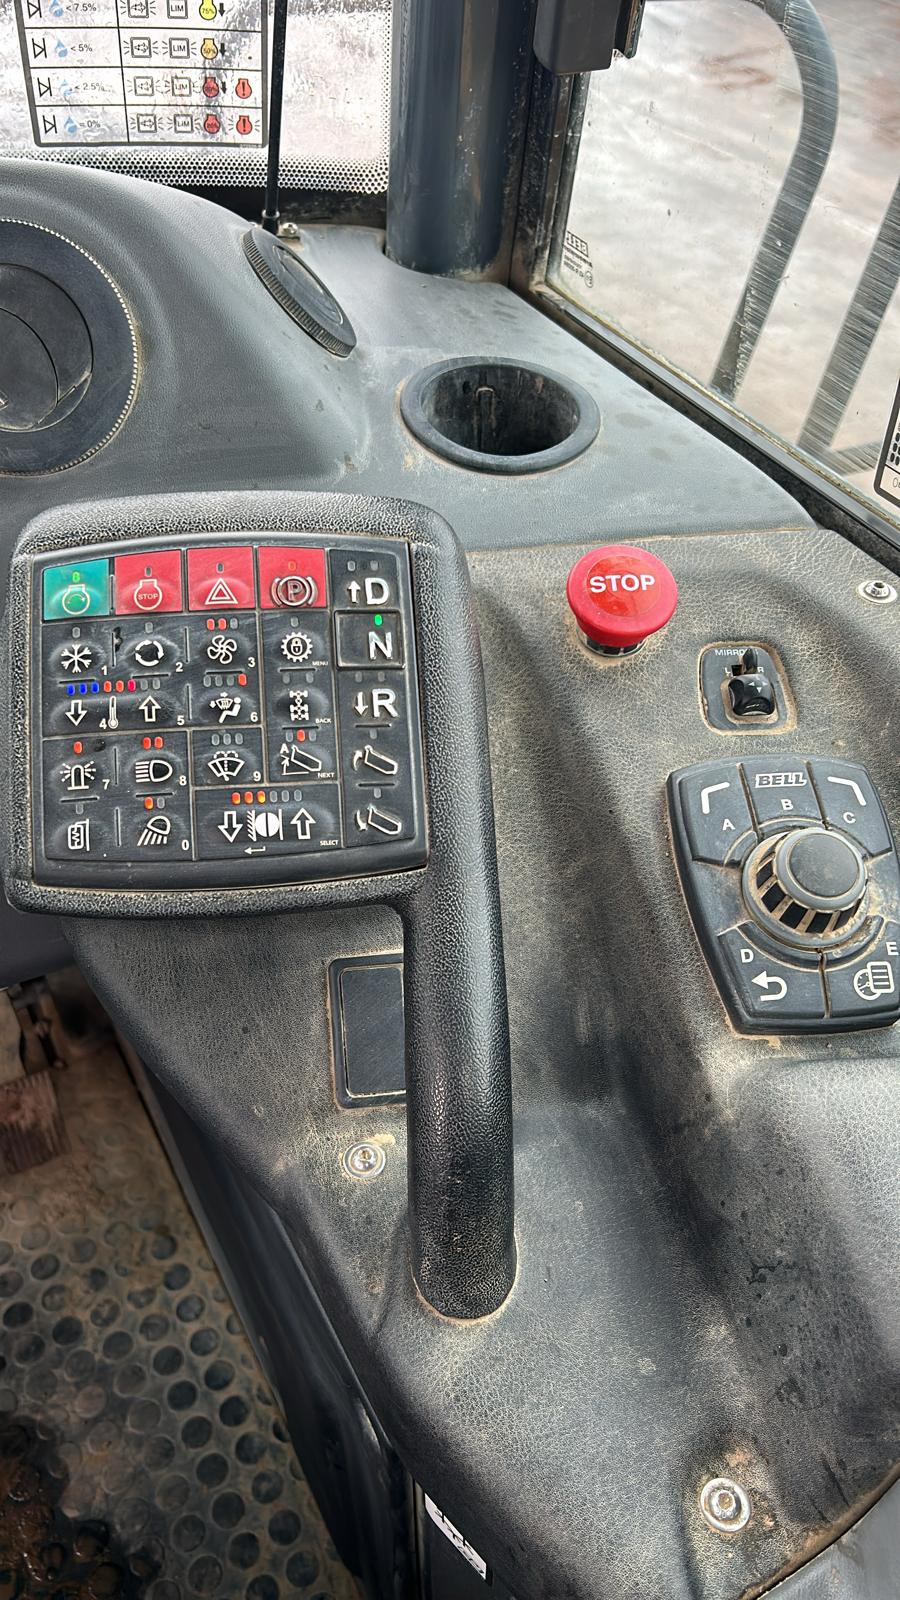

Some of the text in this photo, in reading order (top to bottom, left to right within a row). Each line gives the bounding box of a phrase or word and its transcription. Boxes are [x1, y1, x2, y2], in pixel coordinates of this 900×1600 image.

[170, 4, 184, 12] LIM
[78, 43, 93, 52] 5%
[172, 44, 186, 52] LIM
[86, 120, 101, 128] 0%
[177, 120, 190, 128] LIM
[589, 573, 656, 594] STOP
[137, 593, 159, 601] STOP
[364, 577, 390, 606] D
[368, 631, 393, 660] N
[175, 662, 184, 672] 2
[248, 656, 256, 668] 3
[101, 665, 108, 675] 1
[372, 688, 399, 718] R
[177, 715, 185, 726] 5
[250, 711, 258, 722] 6
[99, 718, 107, 729] 4
[179, 775, 187, 786] 8
[253, 771, 261, 782] 9
[755, 771, 807, 788] BELL
[102, 779, 110, 790] 7
[780, 799, 794, 811] B
[842, 812, 857, 824] C
[722, 818, 736, 831] A
[181, 840, 189, 851] 0
[886, 942, 899, 956] E
[740, 949, 754, 963] D
